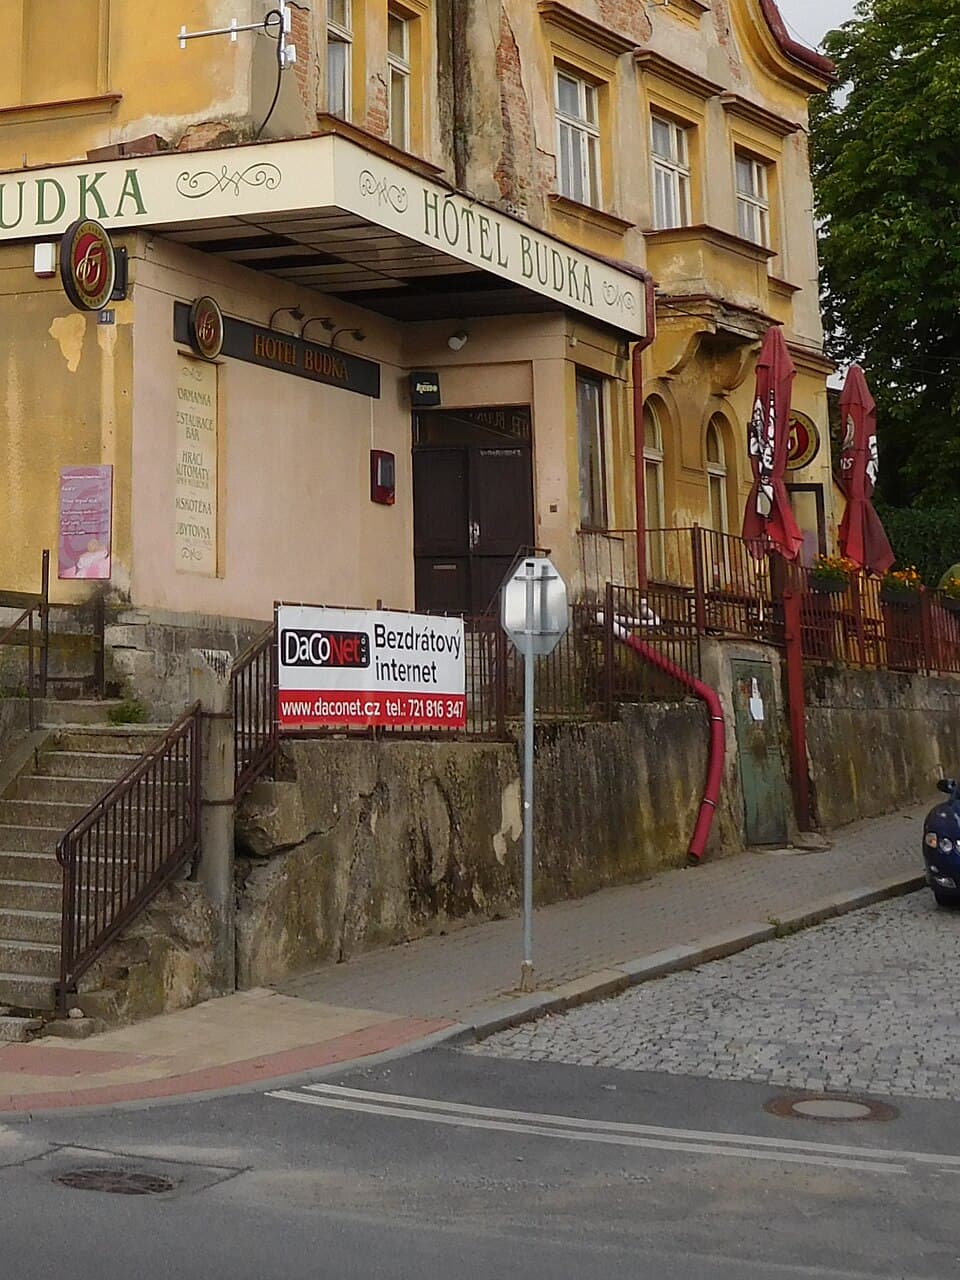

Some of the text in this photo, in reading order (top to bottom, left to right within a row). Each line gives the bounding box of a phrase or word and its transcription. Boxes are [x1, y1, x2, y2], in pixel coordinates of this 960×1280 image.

[422, 188, 594, 307] HOTEL BUDKA
[254, 334, 349, 381] HOTEL BUDKA
[176, 387, 211, 407] ORMANKA
[176, 411, 214, 431] ESTAURACE
[285, 631, 359, 665] DaCoNet
[374, 623, 461, 660] Bezdrátový
[375, 656, 437, 683] internet
[281, 697, 464, 719] www.daconet.cz tel.: 721 816 347
